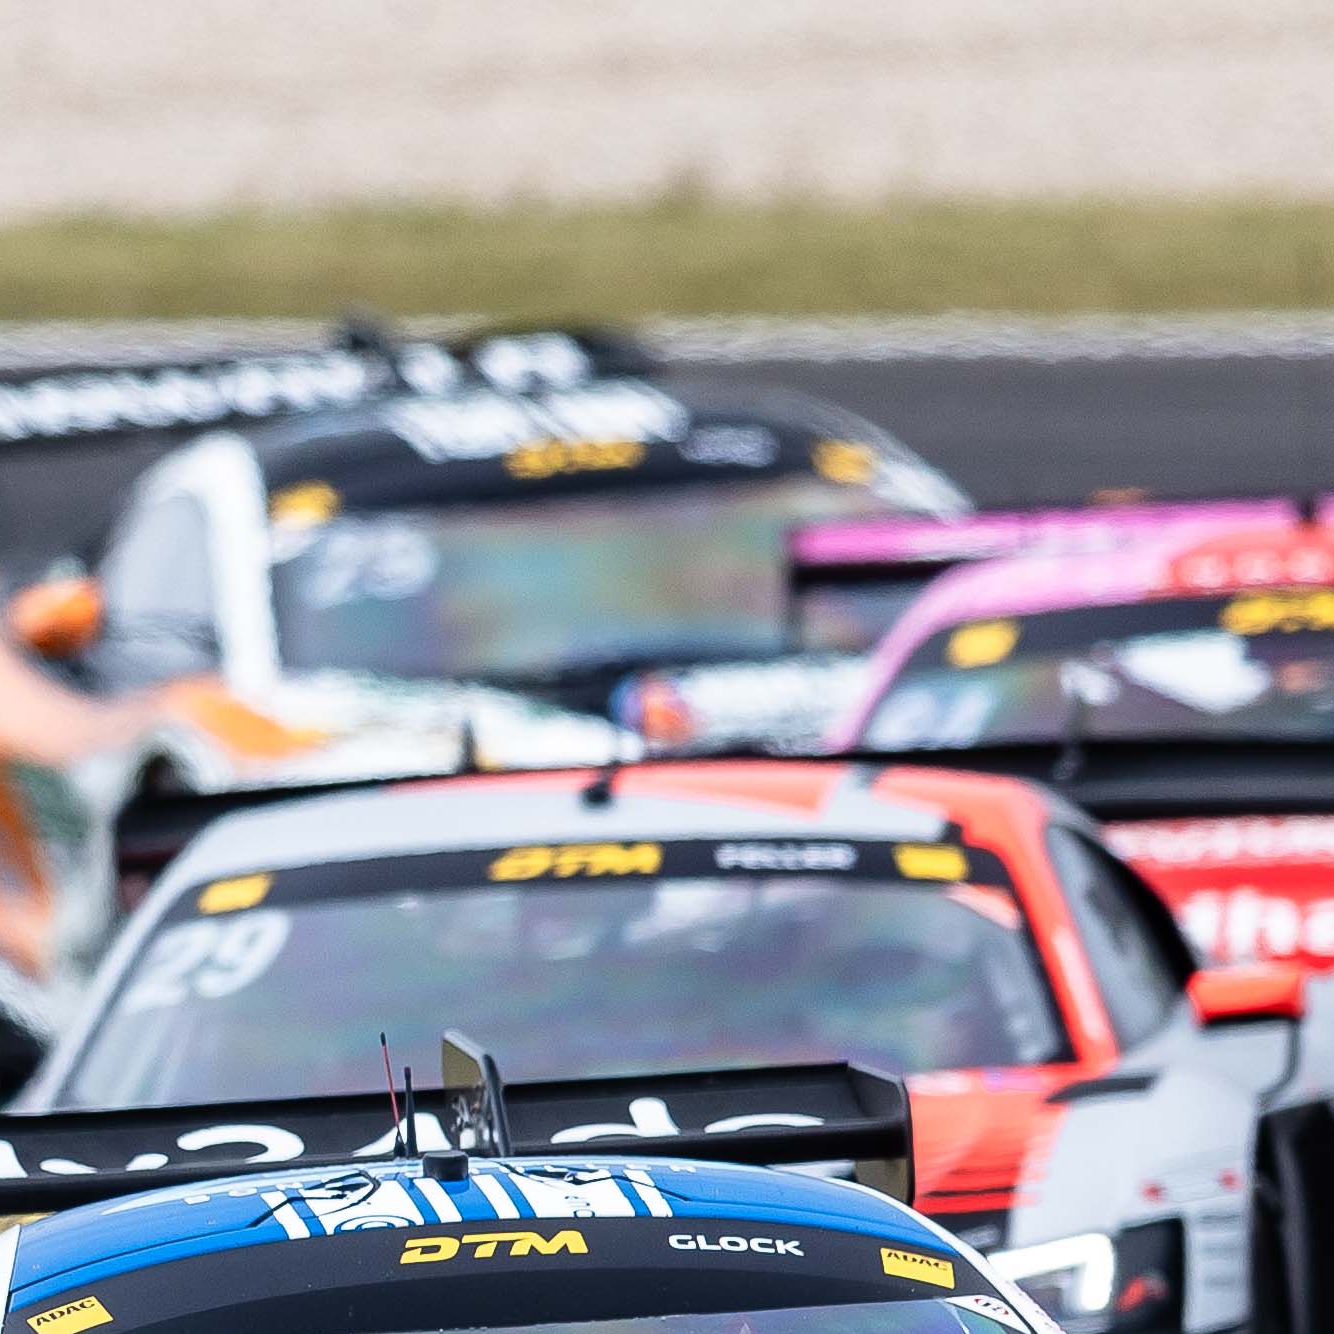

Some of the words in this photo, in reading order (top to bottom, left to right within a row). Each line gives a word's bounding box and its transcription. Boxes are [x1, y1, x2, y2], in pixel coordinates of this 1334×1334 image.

[123, 910, 289, 1012] 29
[400, 1230, 588, 1264] DTM
[668, 1234, 804, 1257] GLOCK
[886, 1251, 951, 1272] ADAC
[35, 1299, 97, 1327] ADAC
